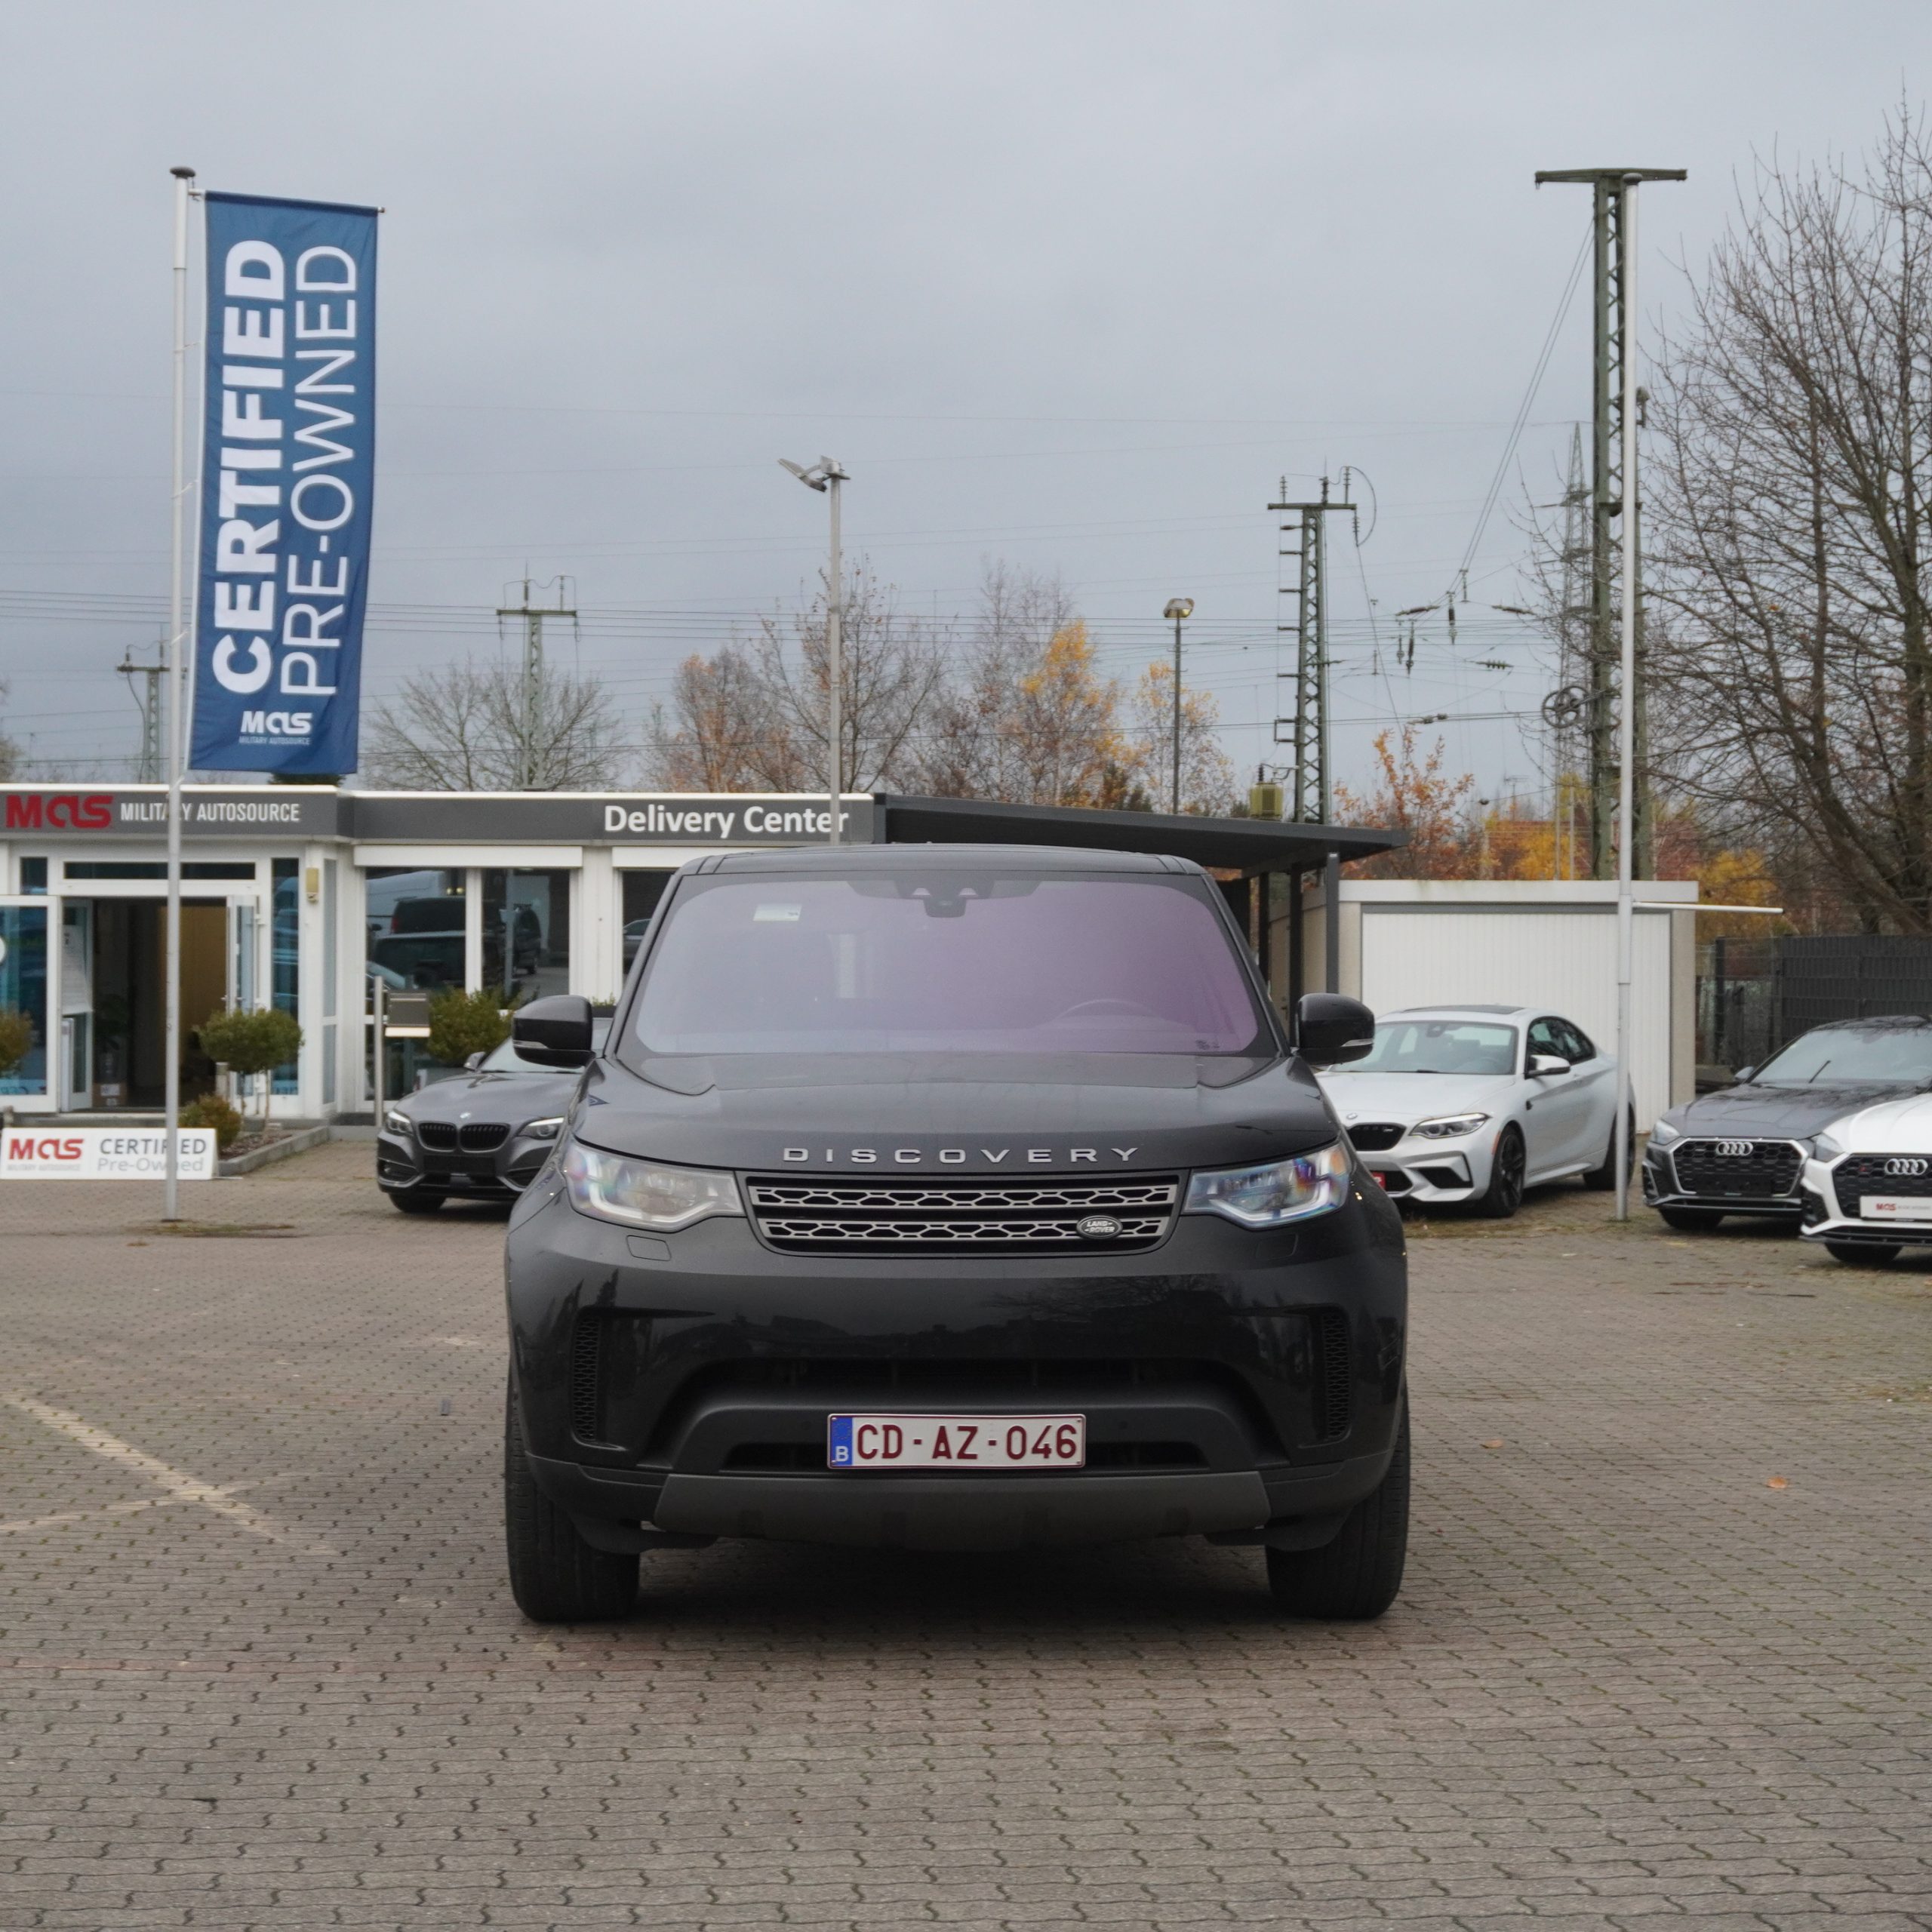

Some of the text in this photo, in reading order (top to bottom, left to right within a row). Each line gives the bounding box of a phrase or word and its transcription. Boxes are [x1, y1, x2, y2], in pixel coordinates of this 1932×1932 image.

[213, 239, 285, 694] CERTIFIED
[280, 245, 357, 695] PRE-OWNED
[196, 803, 300, 822] AUTOSOURCE
[605, 804, 849, 838] Delivery Center
[100, 1138, 207, 1155] CERTIFED
[783, 1147, 1139, 1164] DISCOVERY
[97, 1157, 204, 1171] Pre-Owed
[835, 1445, 849, 1463] B
